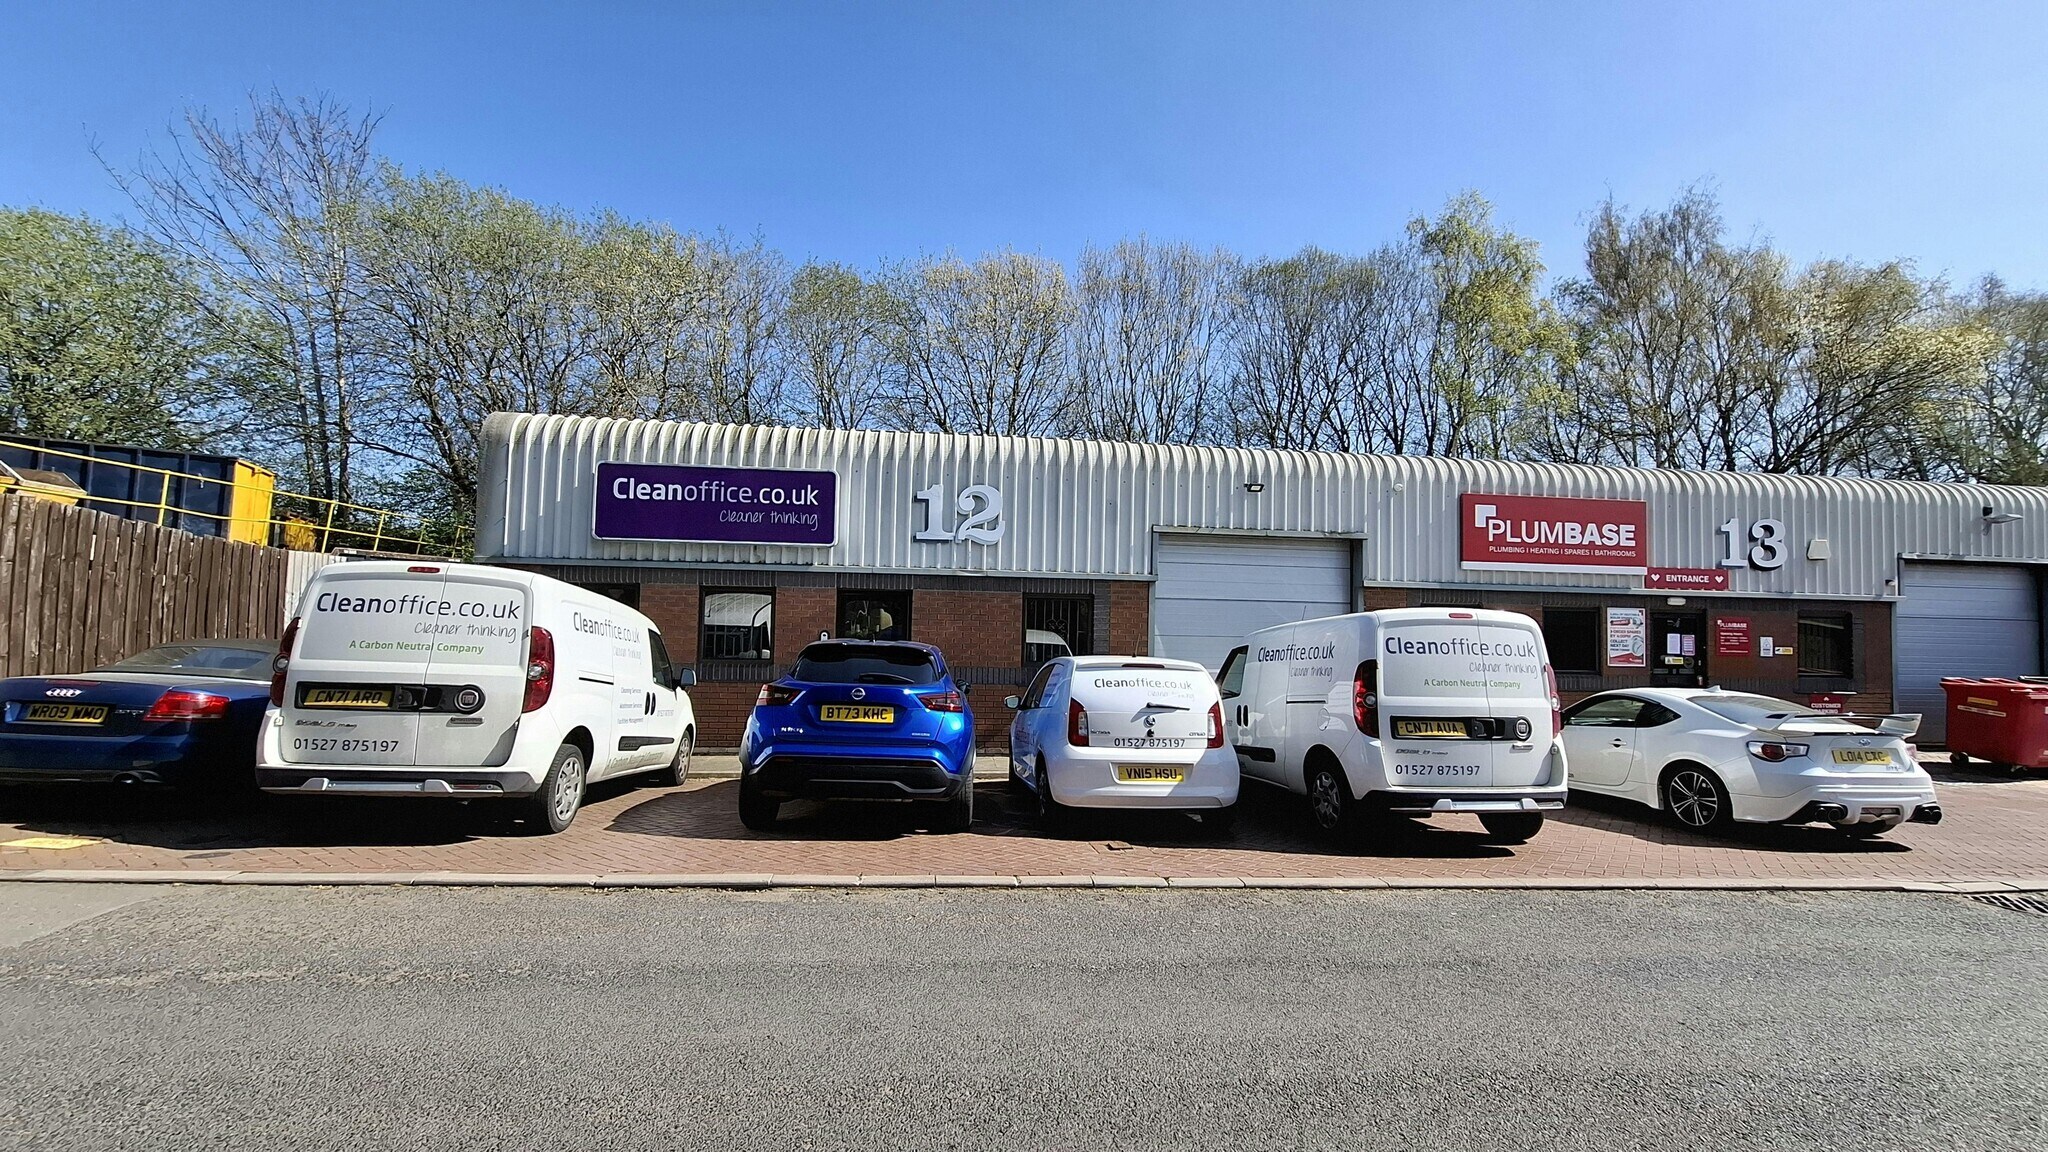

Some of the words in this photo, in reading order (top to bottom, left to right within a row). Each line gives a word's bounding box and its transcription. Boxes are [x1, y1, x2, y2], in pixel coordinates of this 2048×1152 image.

[612, 477, 819, 506] Cleanoffice.co.uk
[719, 509, 765, 523] Cleaner
[770, 510, 819, 531] thinking
[915, 484, 1006, 545] 12
[1488, 519, 1636, 547] PLUMBASE
[1720, 518, 1789, 569] 13
[1489, 546, 1525, 554] PLUMBING
[1530, 547, 1560, 555] HEATING
[1564, 548, 1590, 556] SPARES
[1594, 549, 1636, 557] BATHROOMS
[1665, 574, 1710, 583] ENTRANCE
[316, 592, 521, 620] Cleanoffice.co.uk
[414, 622, 462, 635] Cleaner
[466, 623, 517, 644] thinking
[573, 611, 641, 643] Cleanoffice.co.uk
[349, 640, 358, 649] A
[359, 640, 394, 650] Carbon
[396, 641, 434, 651] Neutral
[437, 642, 485, 654] Company
[1257, 641, 1336, 662] Cleanoffice.co.uk
[1384, 636, 1536, 658] Cleanoffice.co.uk
[1469, 662, 1502, 673] Cleaner
[1504, 662, 1538, 679] thinking
[1094, 678, 1192, 690] Cleanoffice.co.uk
[1423, 678, 1430, 687] A
[1431, 678, 1459, 687] Carbon
[1460, 679, 1488, 687] Neutral
[1489, 679, 1521, 690] Company
[314, 690, 350, 704] CN71
[28, 705, 69, 719] WR09
[70, 706, 105, 720] WMO
[826, 706, 860, 720] BT73
[862, 707, 889, 720] KHC
[1404, 722, 1434, 734] CN71
[1437, 722, 1459, 733] AUA
[293, 738, 338, 751] 01527
[341, 739, 399, 752] 875197
[1114, 738, 1146, 747] 01527
[1148, 738, 1186, 748] 875197
[1864, 751, 1886, 762] CXC
[1125, 768, 1152, 779] VN15
[1154, 768, 1178, 779] HSU
[1395, 764, 1433, 775] 01527
[1437, 765, 1481, 776] 875197
